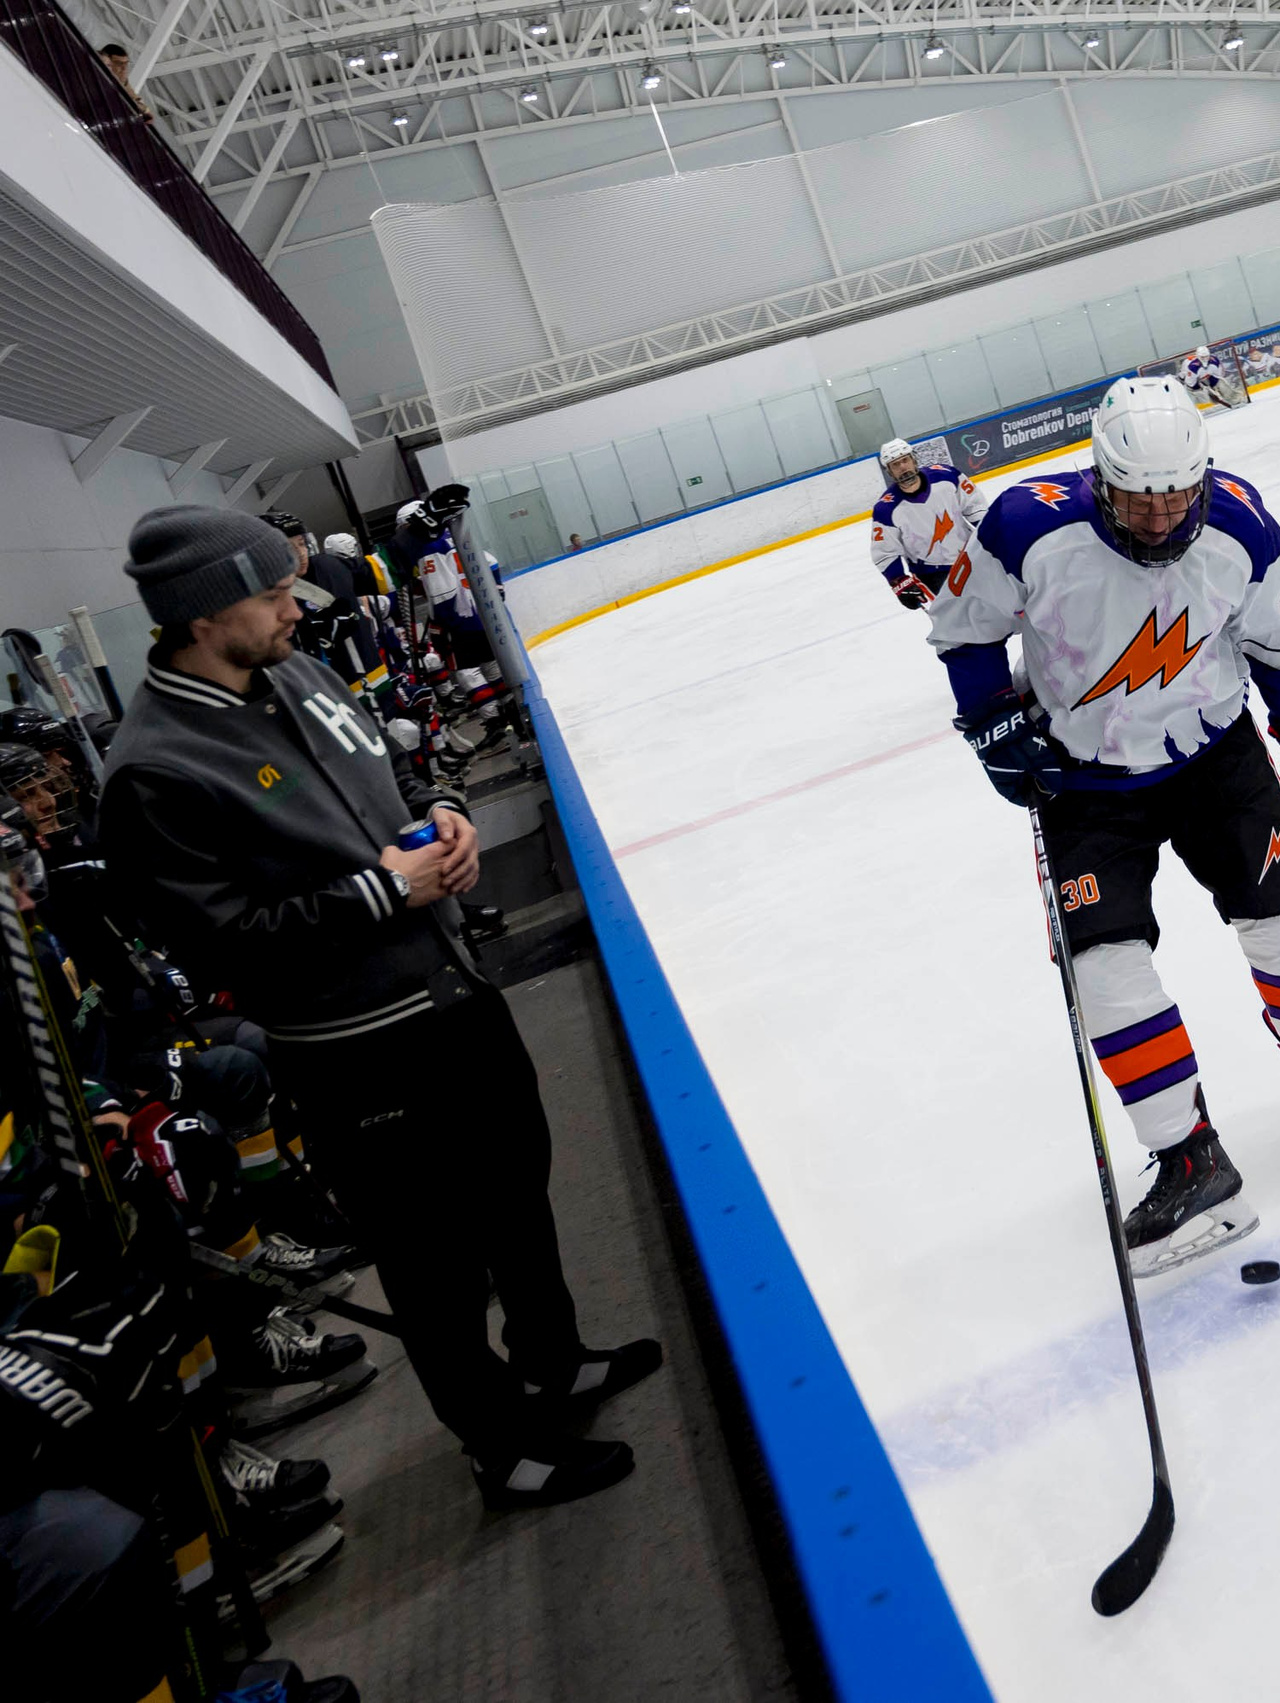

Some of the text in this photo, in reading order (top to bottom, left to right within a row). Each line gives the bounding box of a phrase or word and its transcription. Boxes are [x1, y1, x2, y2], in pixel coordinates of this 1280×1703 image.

[1001, 406, 1063, 433] Стоматология
[1003, 407, 1099, 448] Dobrenkov Denta
[961, 480, 974, 495] 5
[969, 711, 1026, 752] AUER
[1060, 873, 1100, 912] 30
[360, 1108, 405, 1128] CCM
